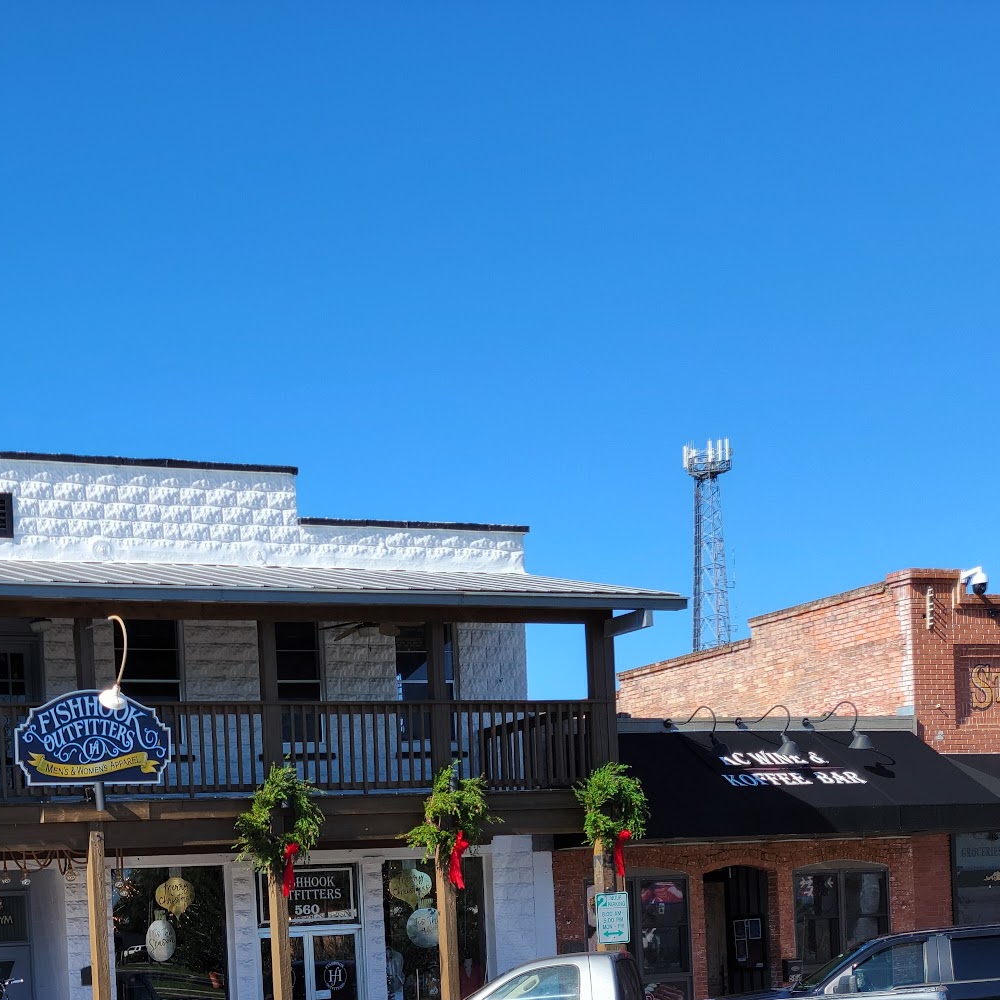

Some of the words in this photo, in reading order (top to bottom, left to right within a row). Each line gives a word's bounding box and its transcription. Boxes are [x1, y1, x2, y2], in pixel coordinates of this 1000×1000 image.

[37, 696, 148, 734] FISHHOOK
[43, 718, 135, 752] OUTFITTERS
[721, 772, 814, 787] KOFFEE
[813, 771, 868, 786] BAR
[294, 876, 336, 888] HHOOK
[288, 888, 342, 901] TFITTERS
[598, 895, 607, 907] 2
[295, 904, 320, 915] 560
